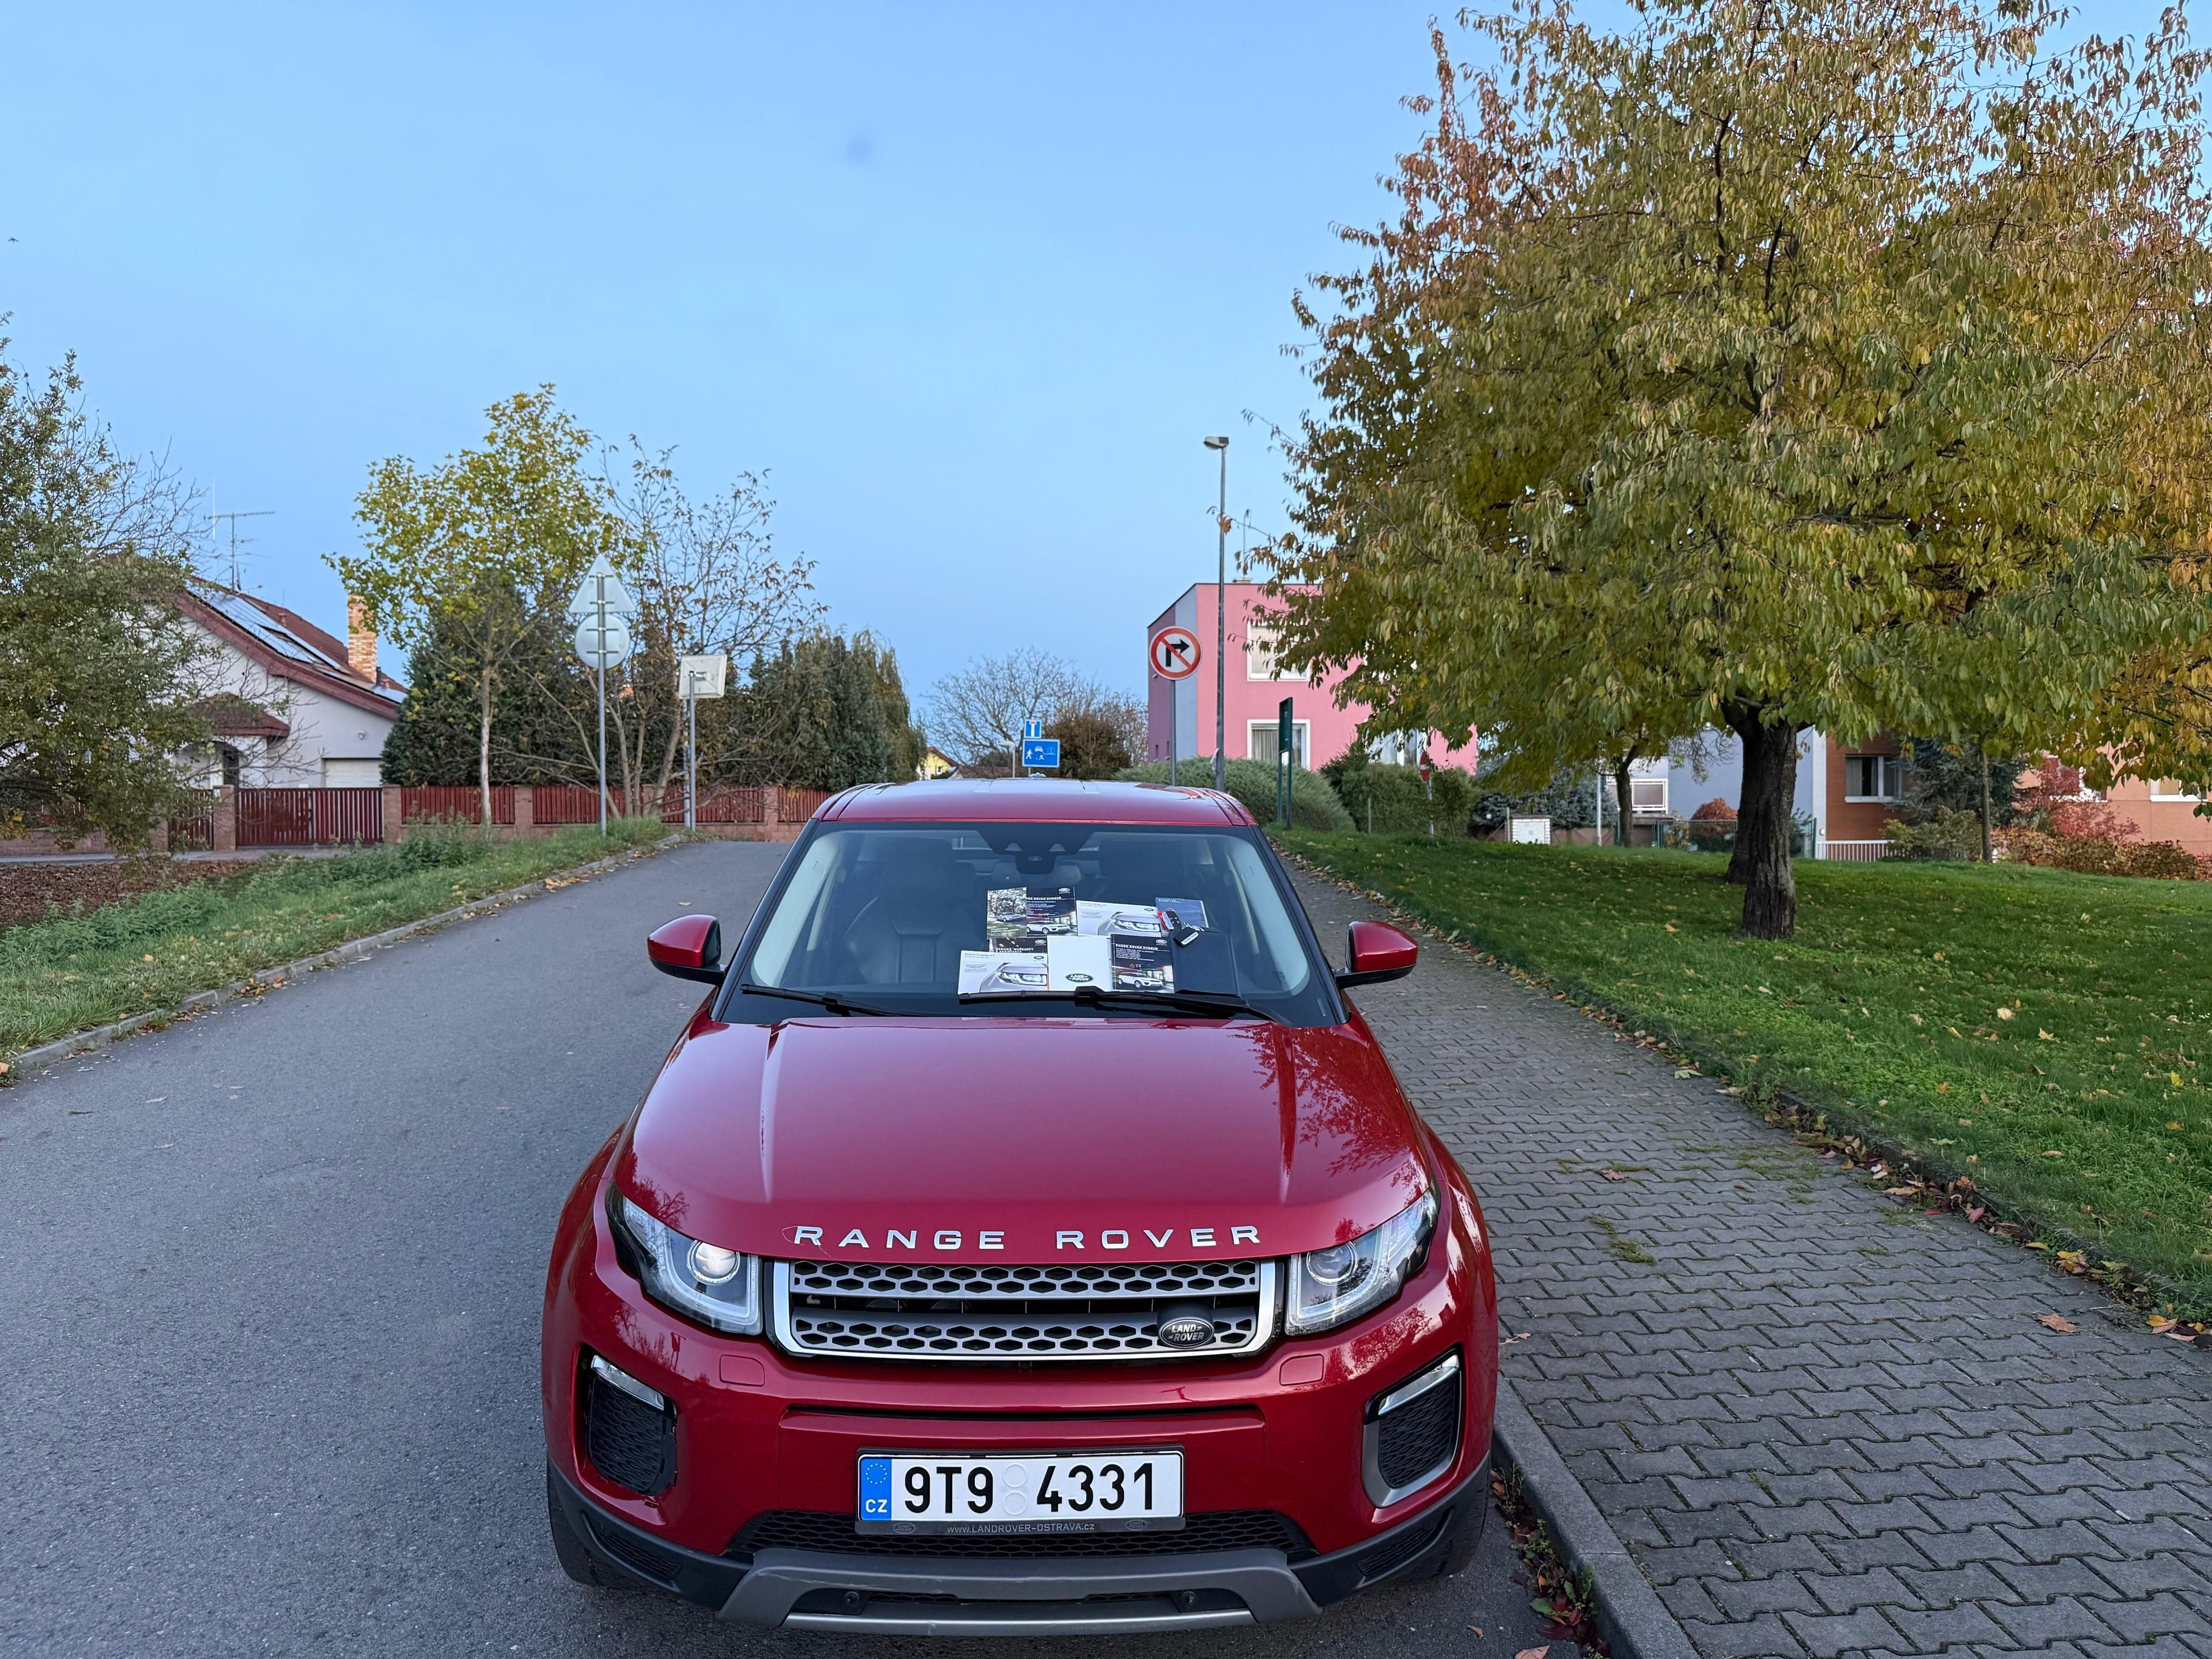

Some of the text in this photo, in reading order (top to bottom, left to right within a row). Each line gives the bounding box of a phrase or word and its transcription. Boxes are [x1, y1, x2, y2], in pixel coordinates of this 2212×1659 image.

[794, 1225, 1260, 1252] RANGE ROVER
[1171, 1324, 1197, 1333] LAND
[1174, 1332, 1204, 1341] ROVER
[905, 1462, 1154, 1514] 9T9 4331
[865, 1499, 887, 1513] CZ
[947, 1523, 1095, 1533] www.LANDROVER-OSTRAVA.cz
